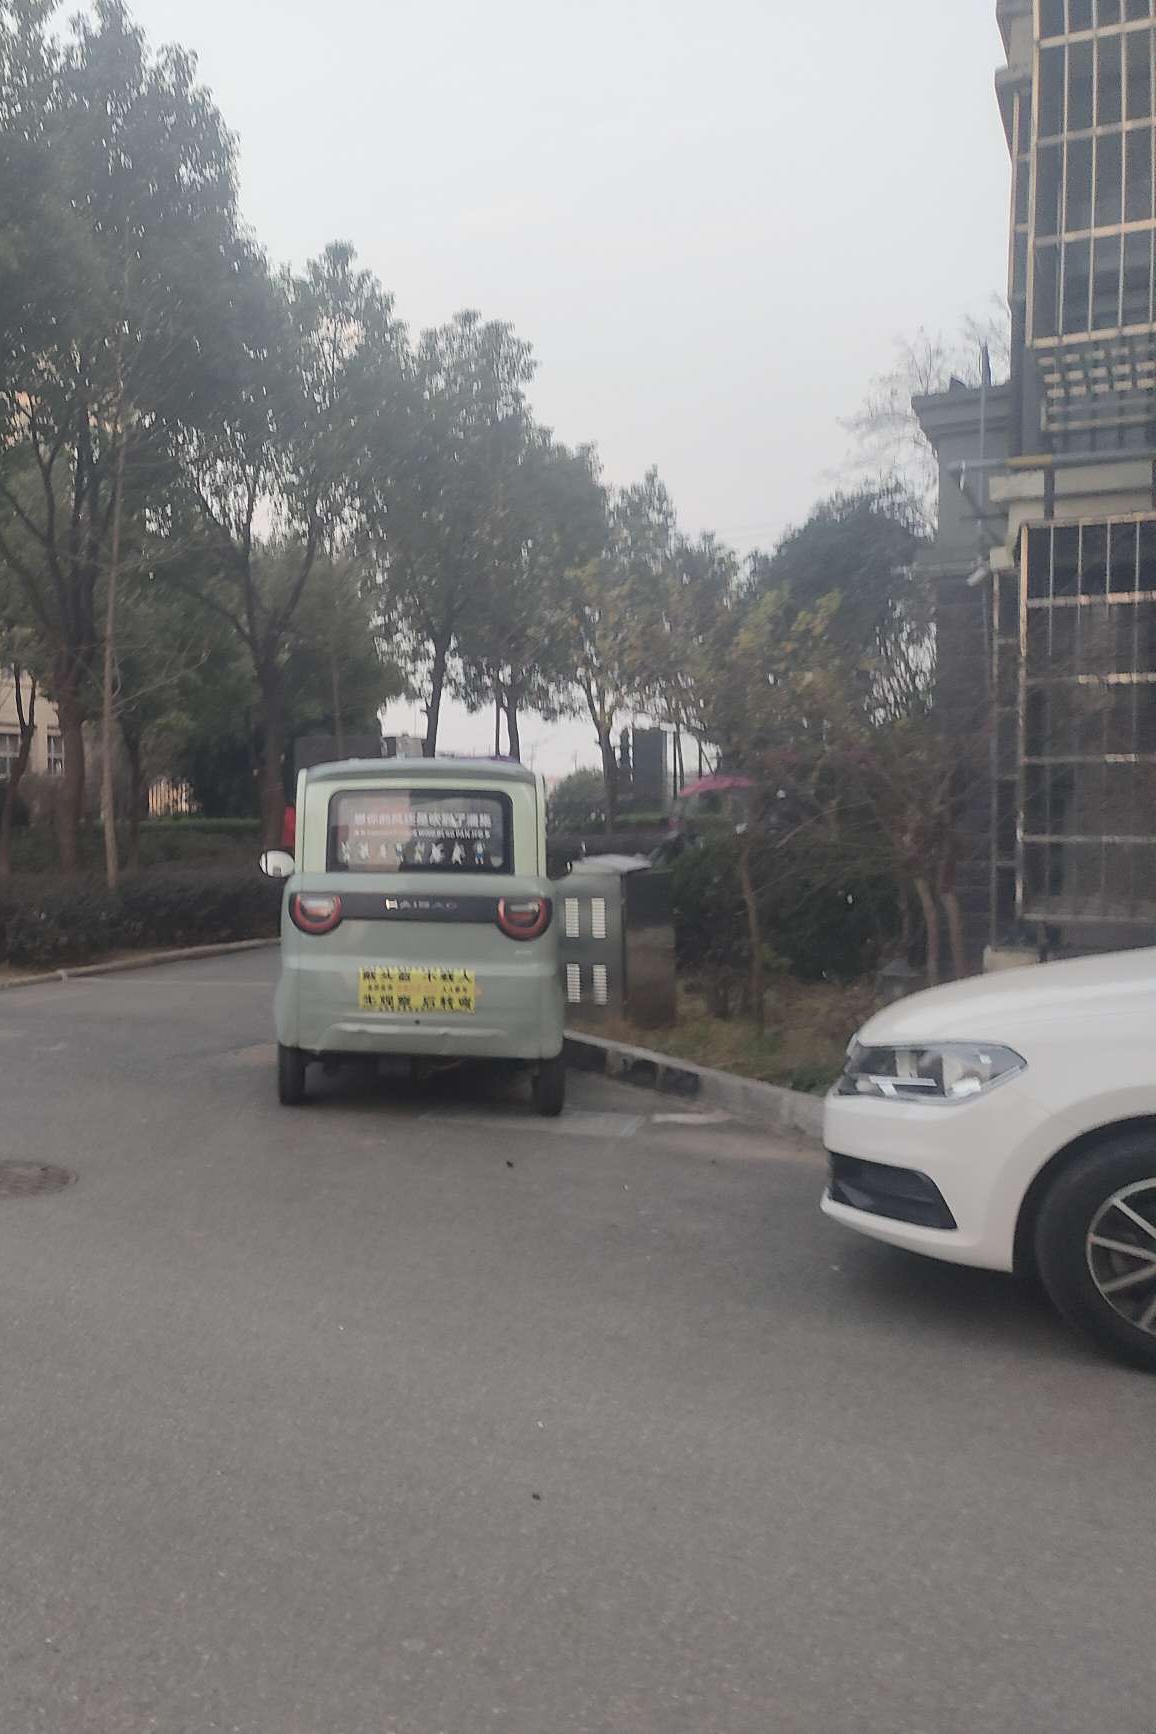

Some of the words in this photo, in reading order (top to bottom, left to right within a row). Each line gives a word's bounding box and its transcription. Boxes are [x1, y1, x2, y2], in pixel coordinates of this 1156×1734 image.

[362, 968, 411, 982] 戴头盔
[424, 969, 472, 983] 不载人
[362, 994, 411, 1009] 先观察
